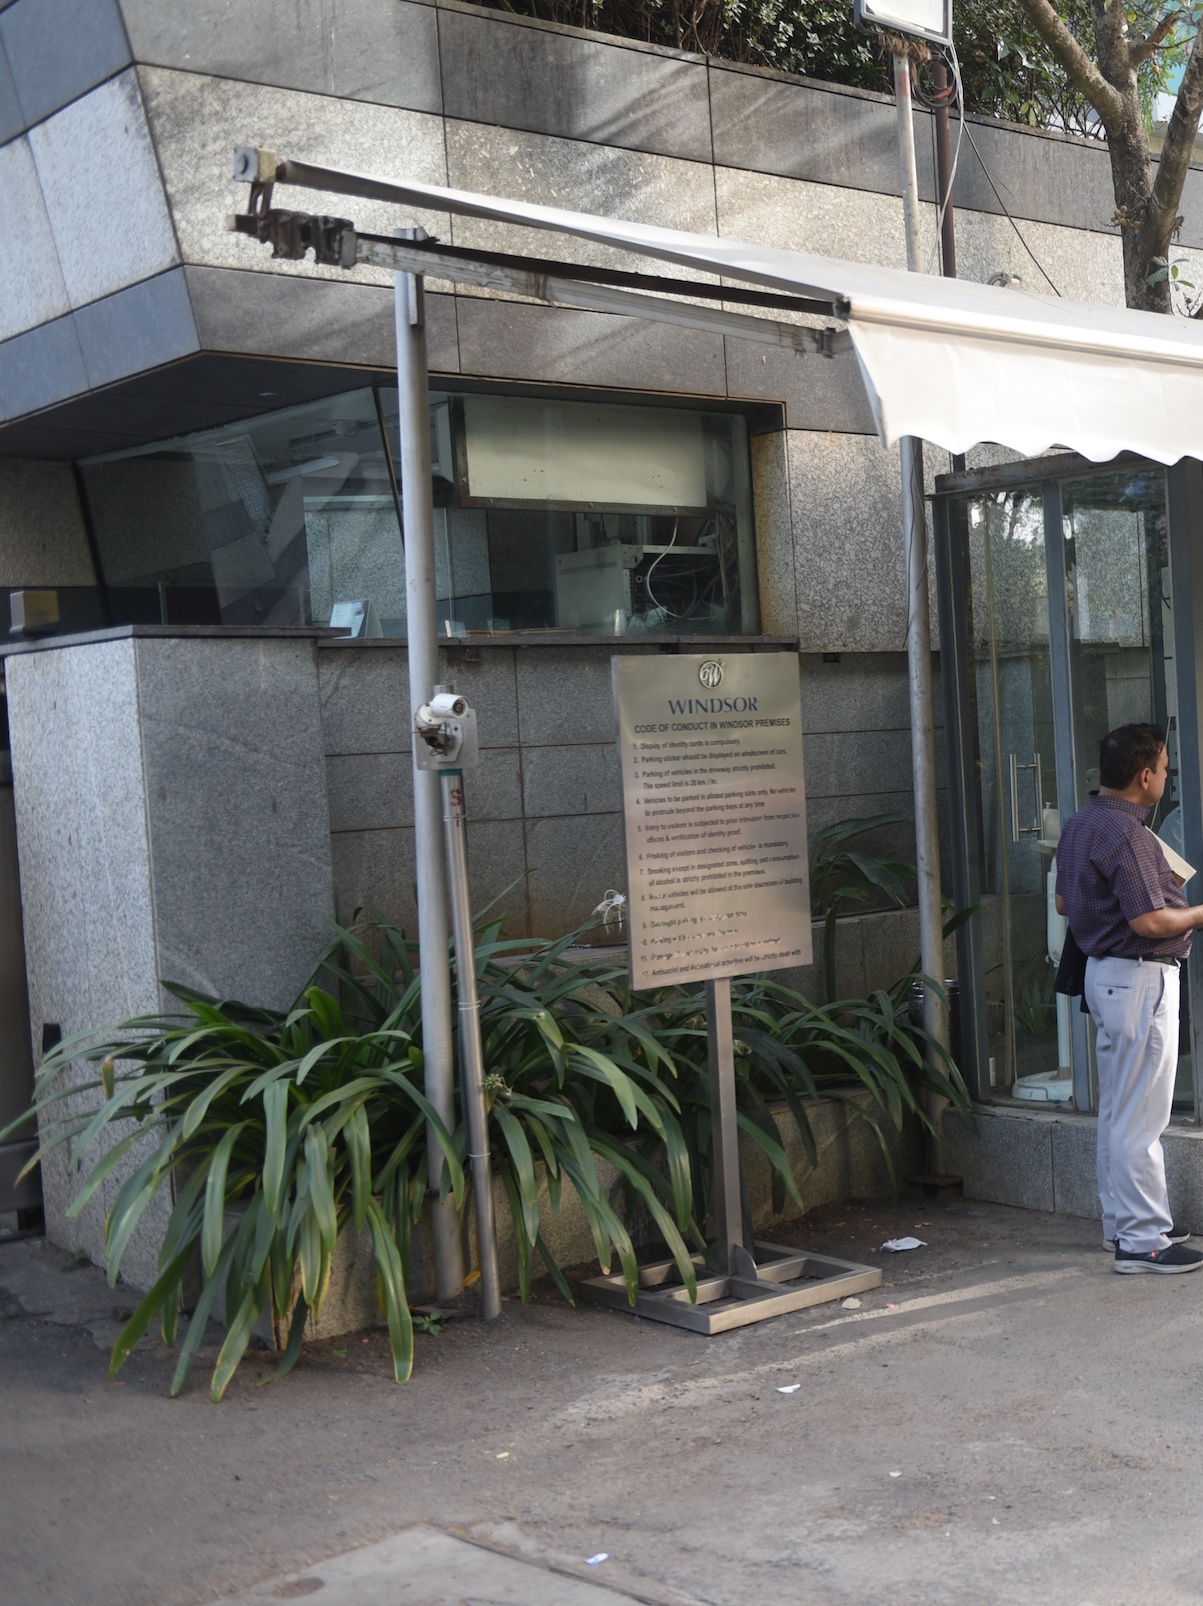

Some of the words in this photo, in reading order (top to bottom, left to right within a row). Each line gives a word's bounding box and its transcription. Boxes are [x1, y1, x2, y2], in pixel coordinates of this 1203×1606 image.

[668, 696, 758, 714] WINDSOR
[634, 724, 656, 733] CODE
[659, 724, 670, 732] OF
[672, 722, 708, 731] CONDUCT
[719, 720, 754, 729] WINDSOR
[756, 718, 790, 727] PREMISES
[682, 794, 700, 802] parked
[652, 808, 674, 817] protrude
[676, 806, 696, 814] beyond
[706, 804, 724, 812] parking
[648, 866, 671, 875] Smoking
[696, 862, 724, 870] designated
[656, 878, 675, 886] alcohol
[701, 873, 726, 882] prohibited
